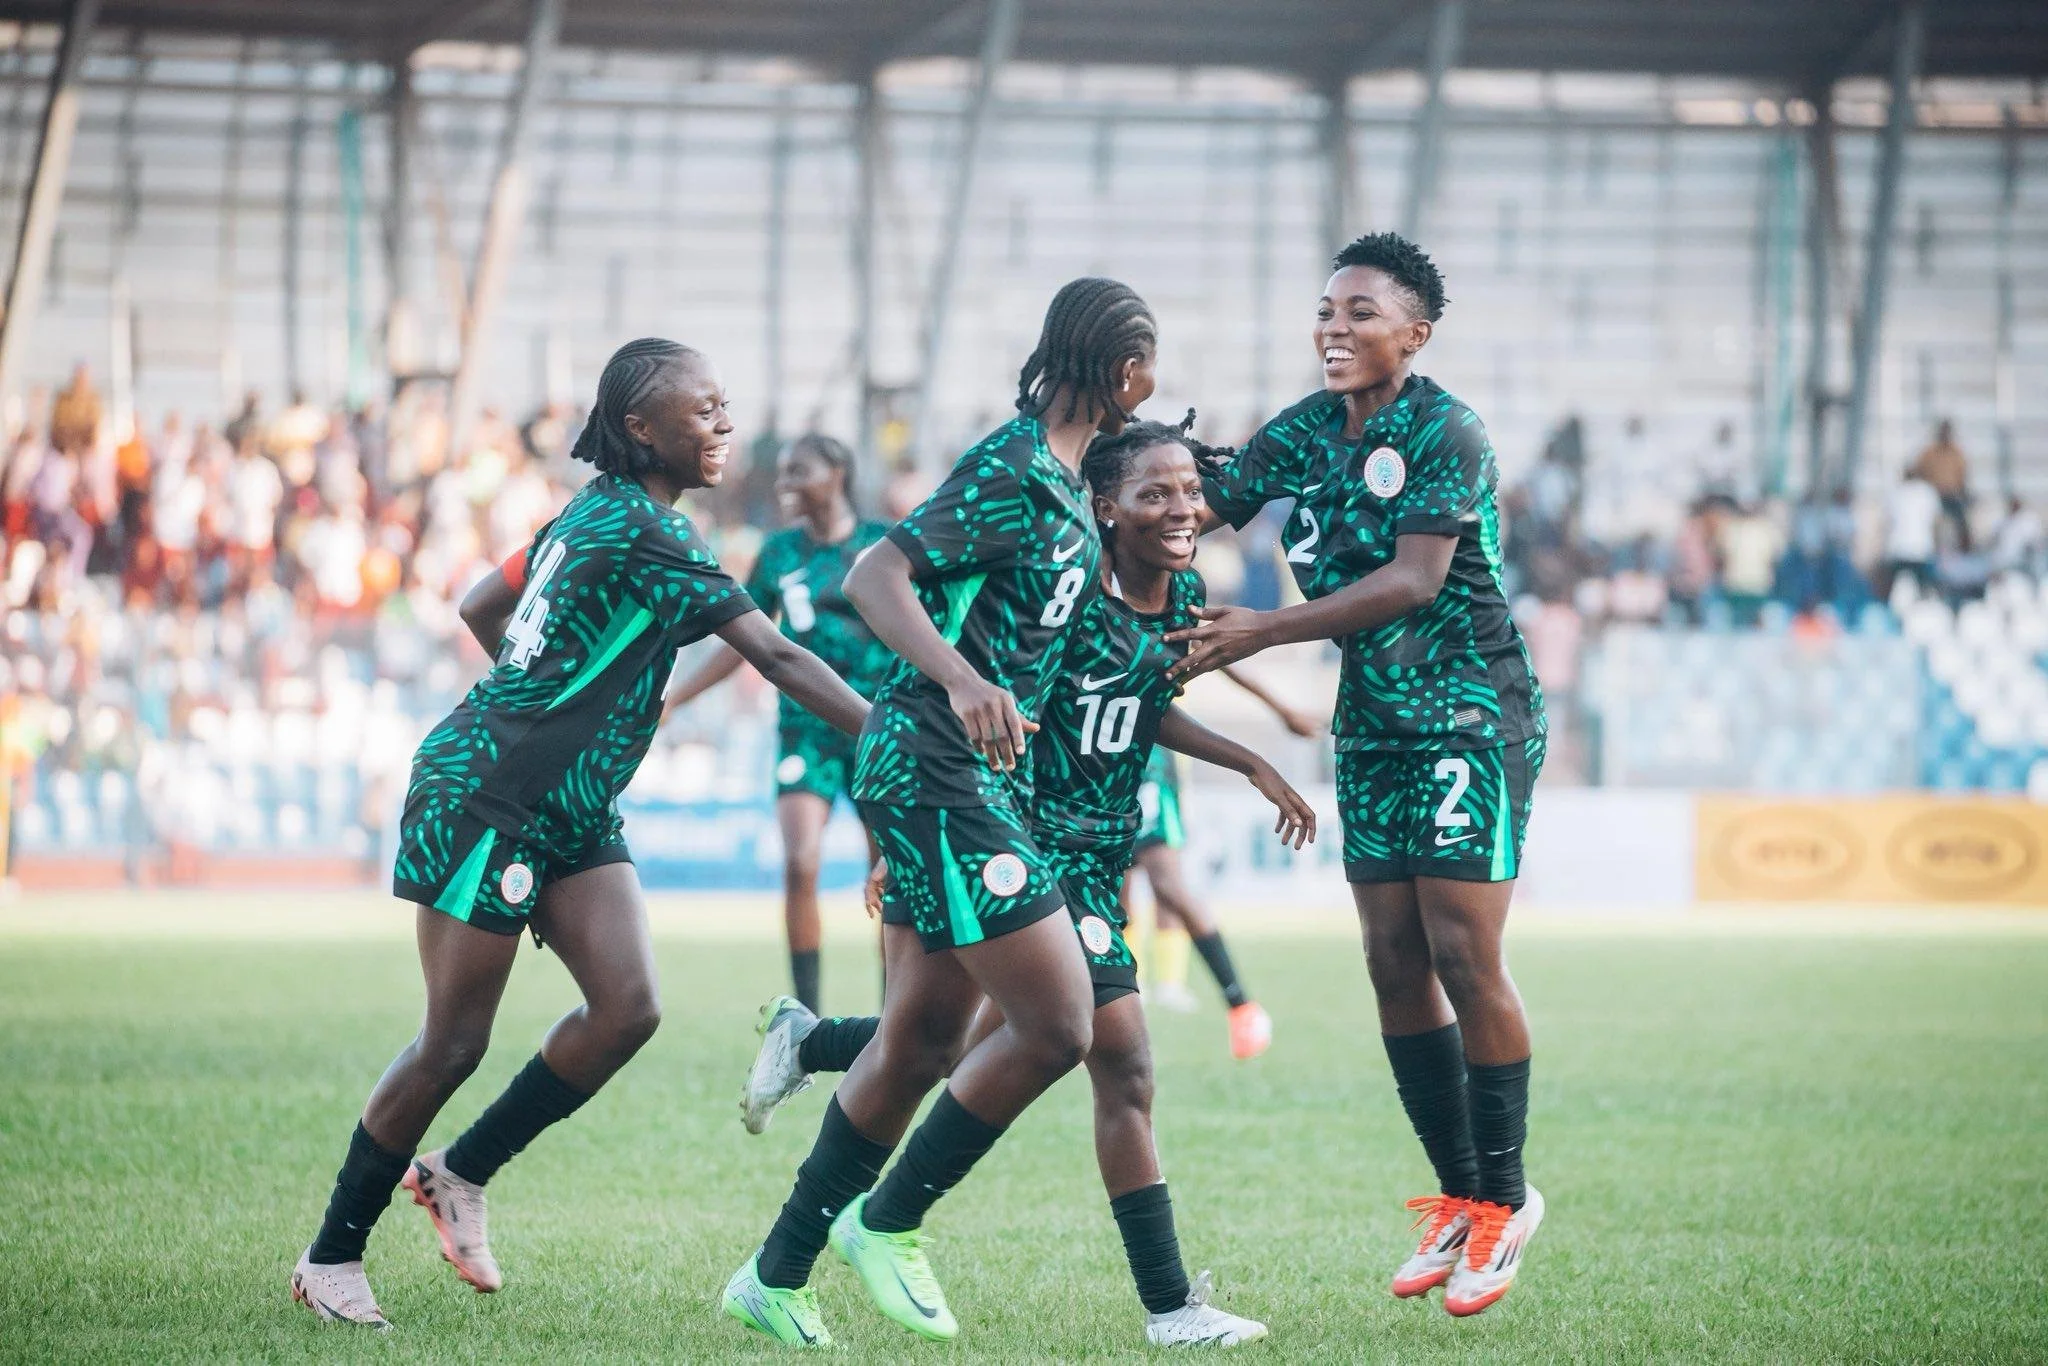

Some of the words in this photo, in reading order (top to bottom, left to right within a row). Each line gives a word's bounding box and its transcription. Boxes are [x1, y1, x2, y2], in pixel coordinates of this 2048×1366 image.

[1287, 507, 1320, 564] 2
[1039, 567, 1086, 628] 8
[1076, 694, 1142, 755] 10
[1434, 757, 1471, 827] 2
